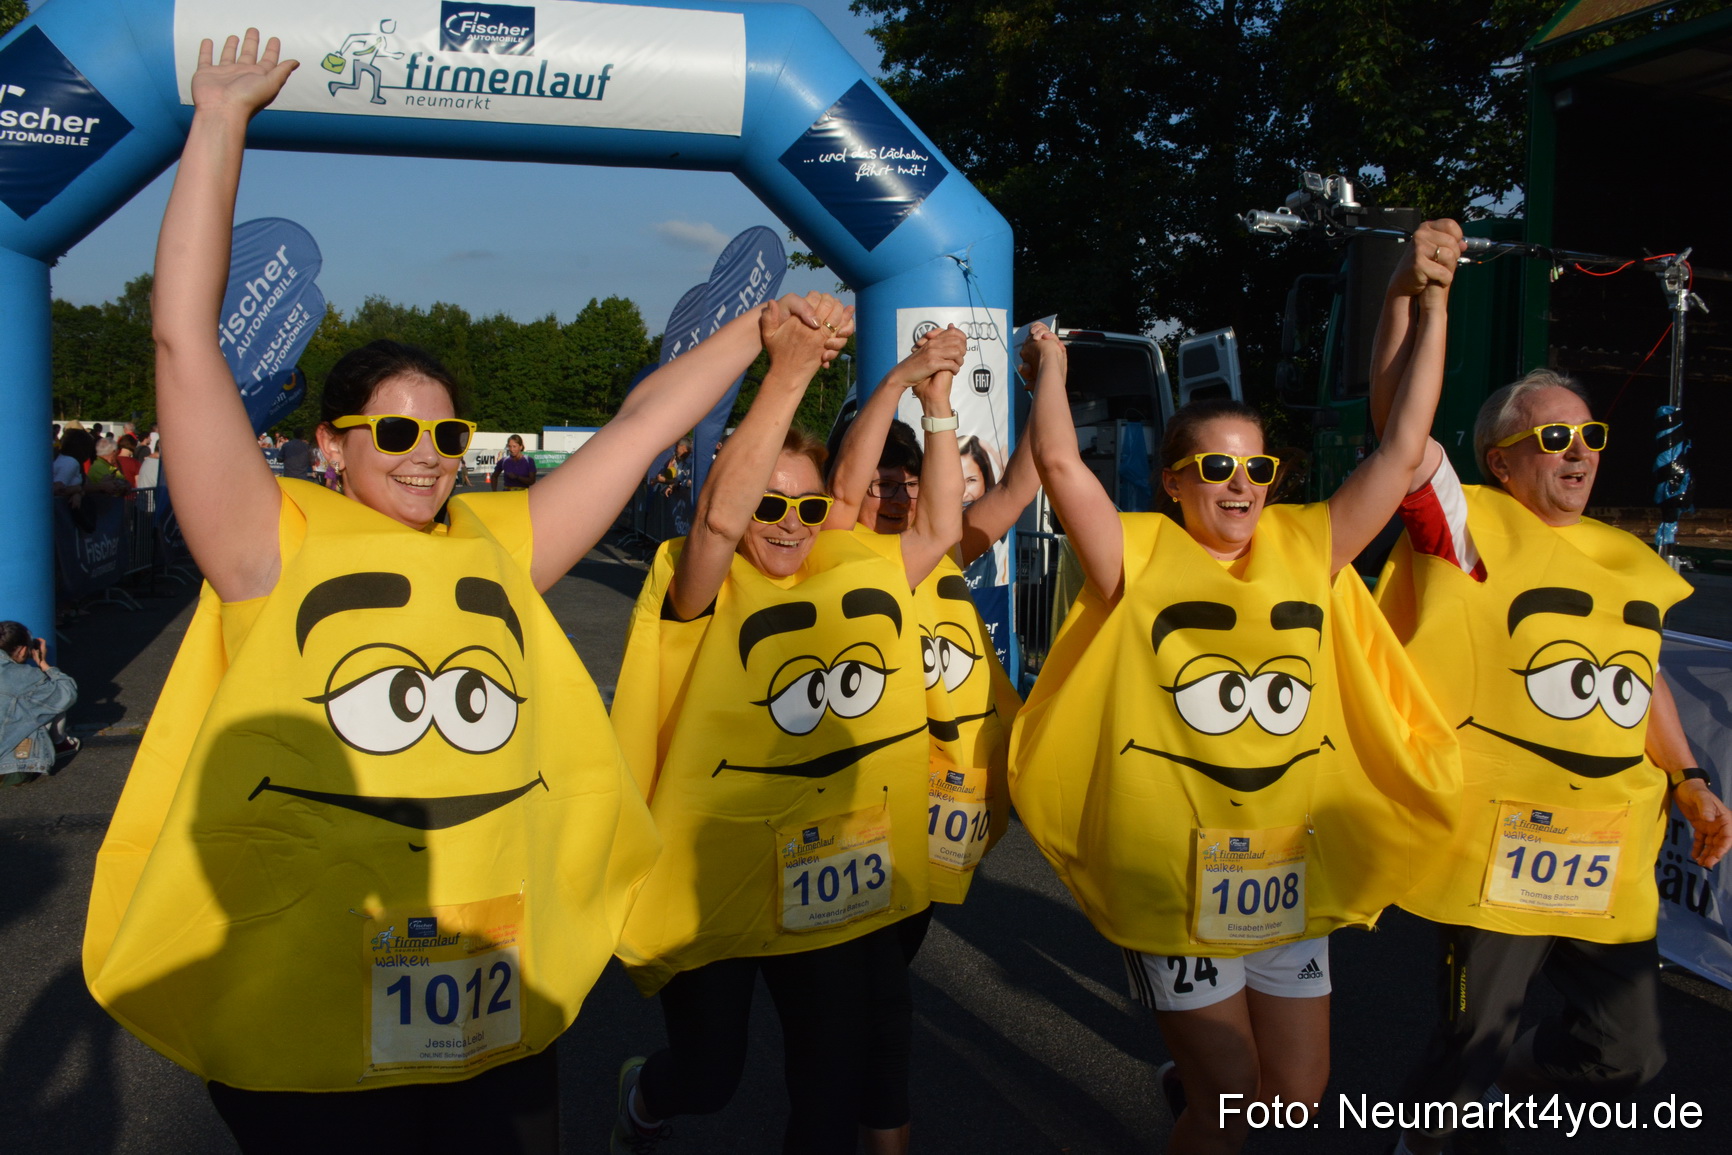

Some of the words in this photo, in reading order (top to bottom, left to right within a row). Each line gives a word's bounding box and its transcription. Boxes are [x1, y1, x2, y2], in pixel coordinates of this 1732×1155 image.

[460, 20, 530, 37] Fischer
[466, 34, 523, 43] AUTOMOBILE
[405, 52, 614, 100] firmenlauf
[405, 95, 491, 110] neumarkt
[0, 107, 100, 133] scher
[0, 130, 90, 146] UTOMOBILE
[819, 148, 847, 163] und
[851, 145, 877, 160] das
[855, 163, 894, 182] fährt
[897, 164, 927, 177] mit!
[236, 266, 299, 359] AUTOMOBILE
[966, 344, 979, 352] udi
[975, 373, 990, 388] FIAT
[1456, 430, 1465, 446] 7
[935, 778, 976, 794] firmenlauf
[929, 788, 955, 803] alken
[928, 803, 991, 843] 1010
[1519, 820, 1569, 835] firmenlauf
[797, 835, 835, 854] firmenlauf
[1504, 830, 1542, 844] walken
[786, 855, 820, 869] walken
[1220, 850, 1266, 860] firmenlauf
[1205, 863, 1244, 873] walken
[1506, 846, 1611, 888] 1015
[793, 853, 886, 906] 1013
[1212, 872, 1299, 916] 1008
[1520, 889, 1552, 901] Thomas
[1554, 893, 1579, 901] Batsch
[809, 908, 847, 921] Alexandra
[1227, 923, 1264, 932] Elisabeth
[395, 932, 461, 948] firmenlauf
[375, 954, 430, 968] walken
[1166, 955, 1219, 994] 24
[1297, 970, 1324, 980] adidas
[387, 961, 512, 1026] 1012
[425, 1037, 467, 1049] Jessica
